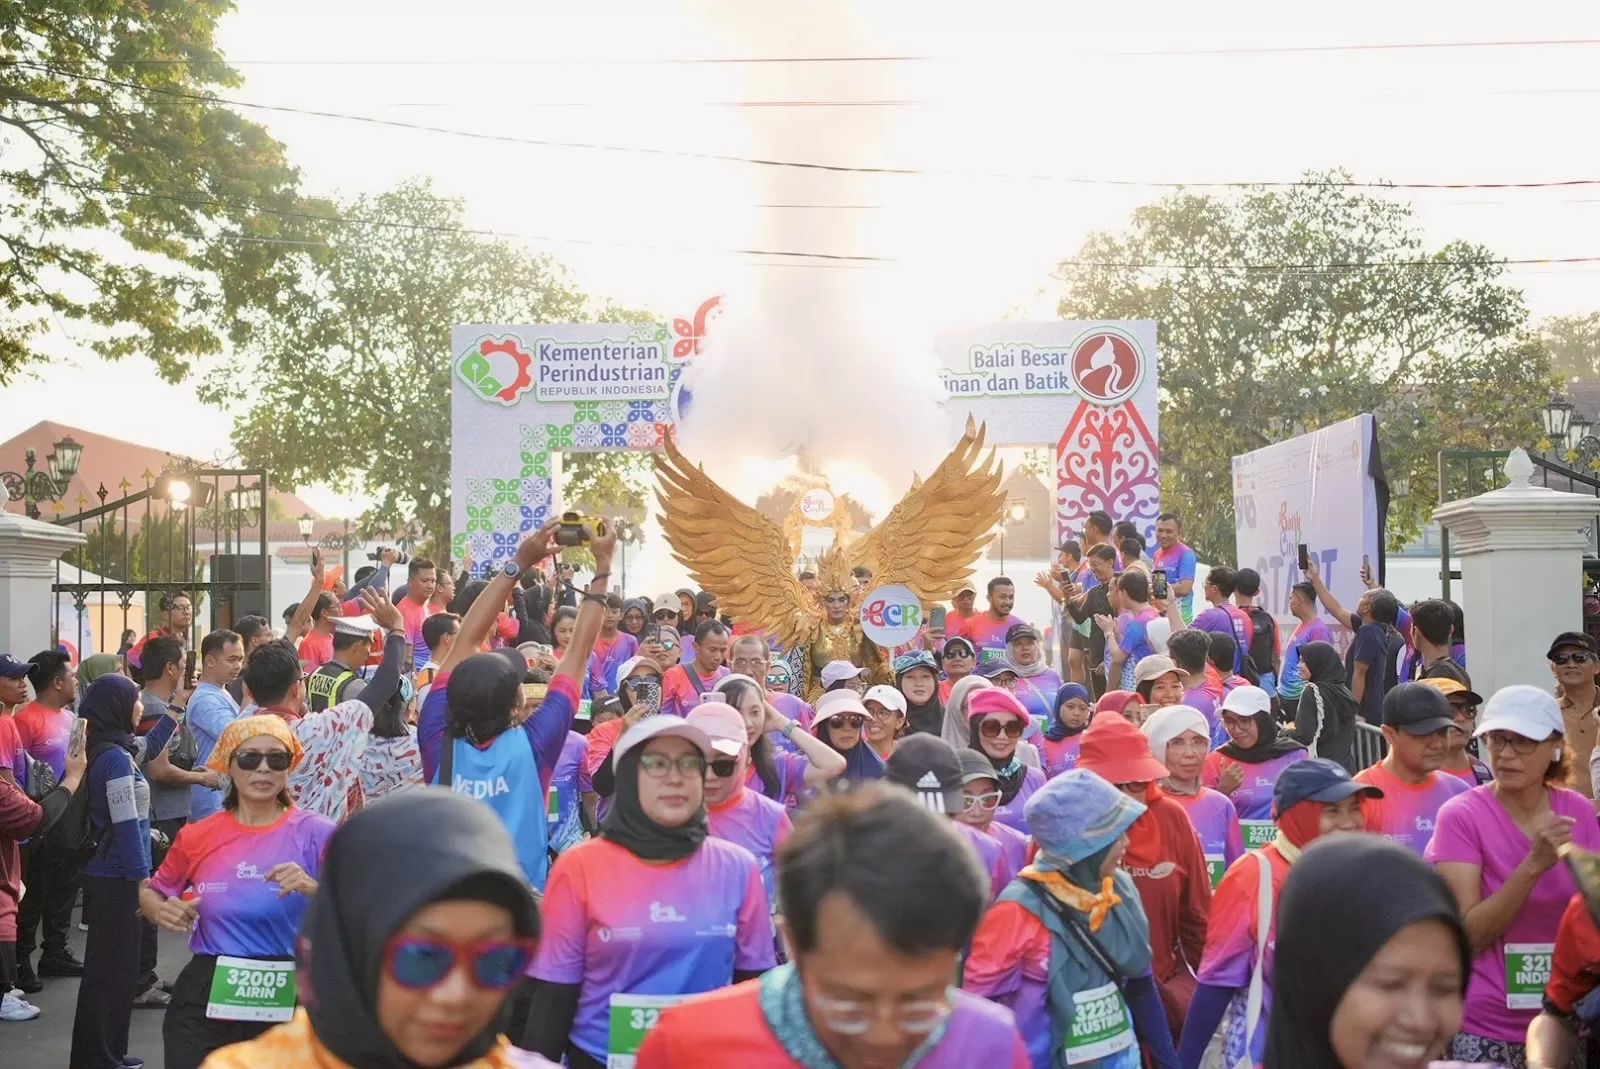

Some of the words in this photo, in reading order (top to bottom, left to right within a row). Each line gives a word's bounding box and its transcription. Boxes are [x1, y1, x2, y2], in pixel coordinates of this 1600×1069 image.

[539, 341, 658, 362] Kementerian
[974, 349, 1015, 368] Balai
[1021, 349, 1068, 367] Besar
[539, 362, 665, 383] Perindustrian
[939, 375, 981, 393] inan
[987, 373, 1019, 391] dan
[1025, 371, 1070, 391] Batik
[540, 387, 598, 396] REPUBLIK
[601, 386, 664, 395] INDONESIA
[226, 968, 288, 988] 32005
[234, 985, 276, 999] AIRIN
[1074, 993, 1120, 1023] 32230
